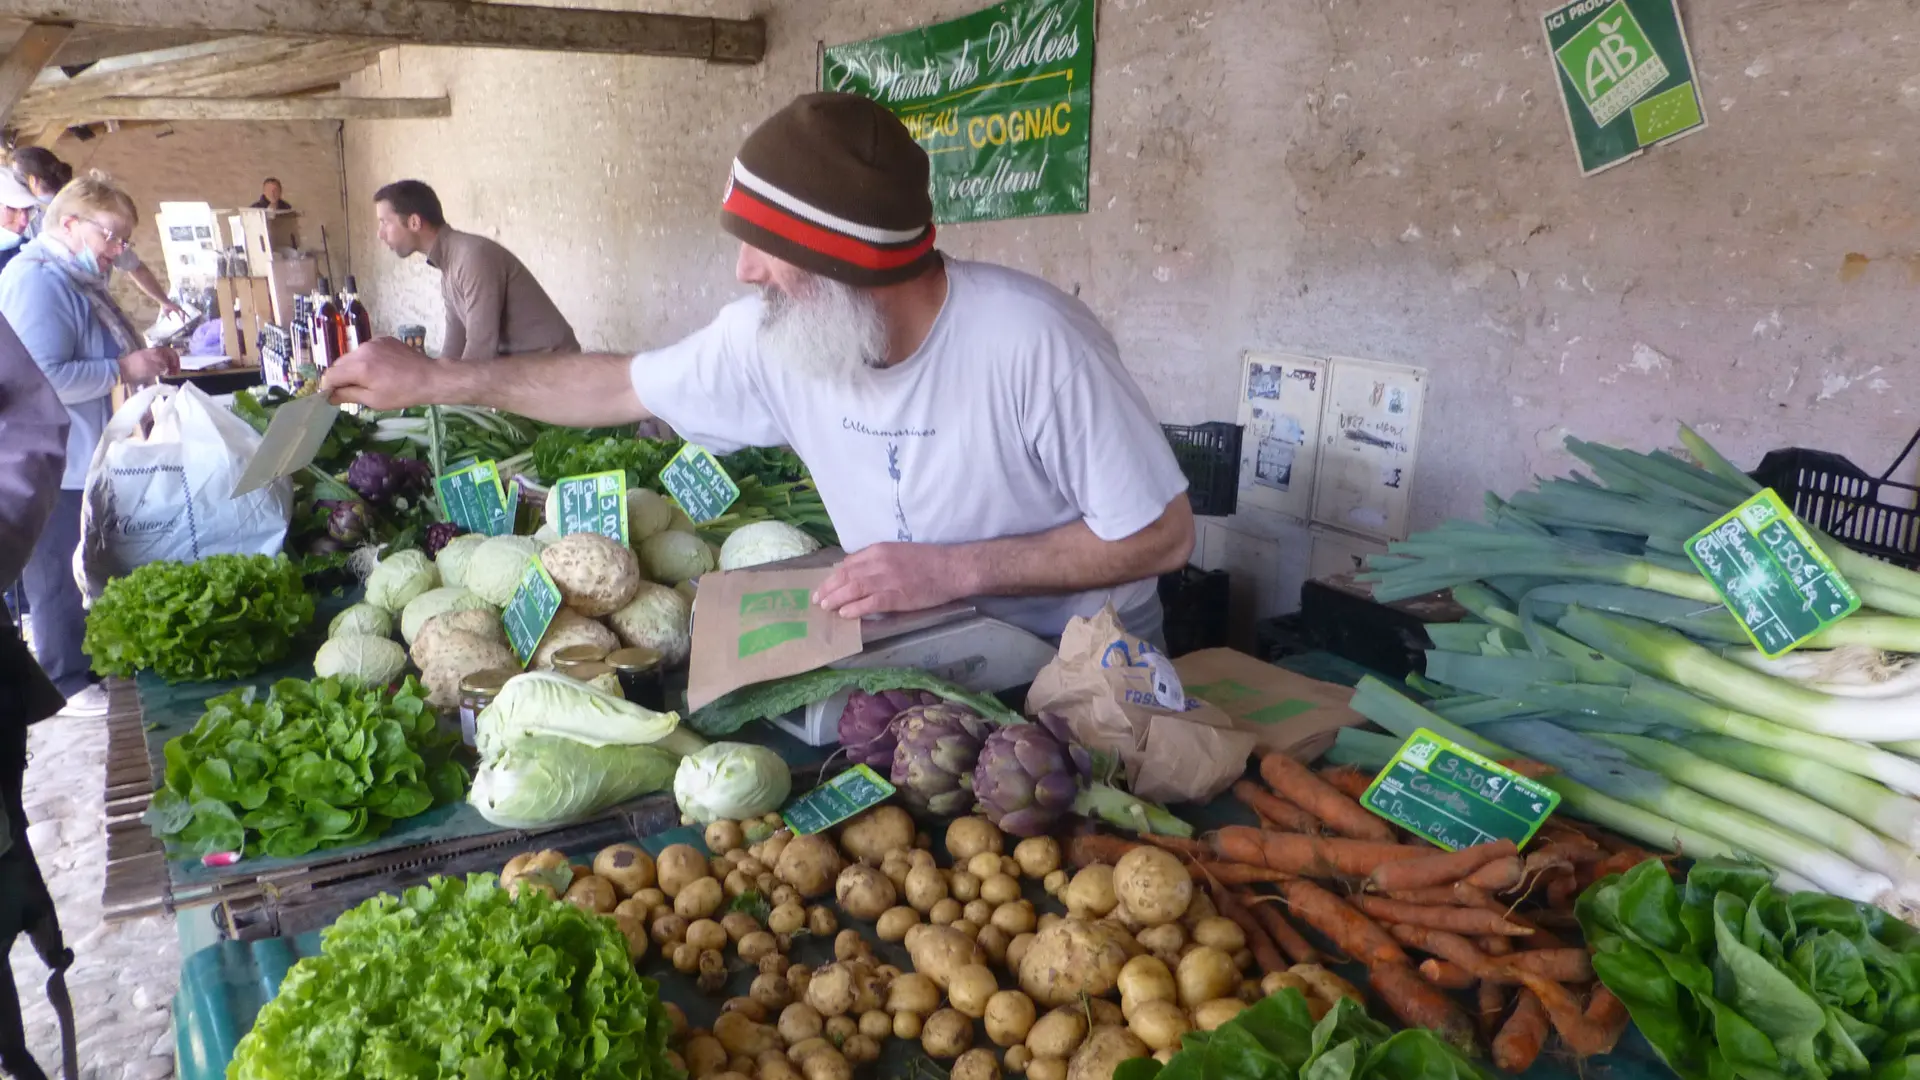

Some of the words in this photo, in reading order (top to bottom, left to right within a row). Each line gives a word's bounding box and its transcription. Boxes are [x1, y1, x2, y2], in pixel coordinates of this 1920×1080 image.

[1548, 12, 1565, 31] ICI
[949, 39, 980, 91] des
[1586, 34, 1637, 99] AB
[968, 102, 1071, 148] COGNAC
